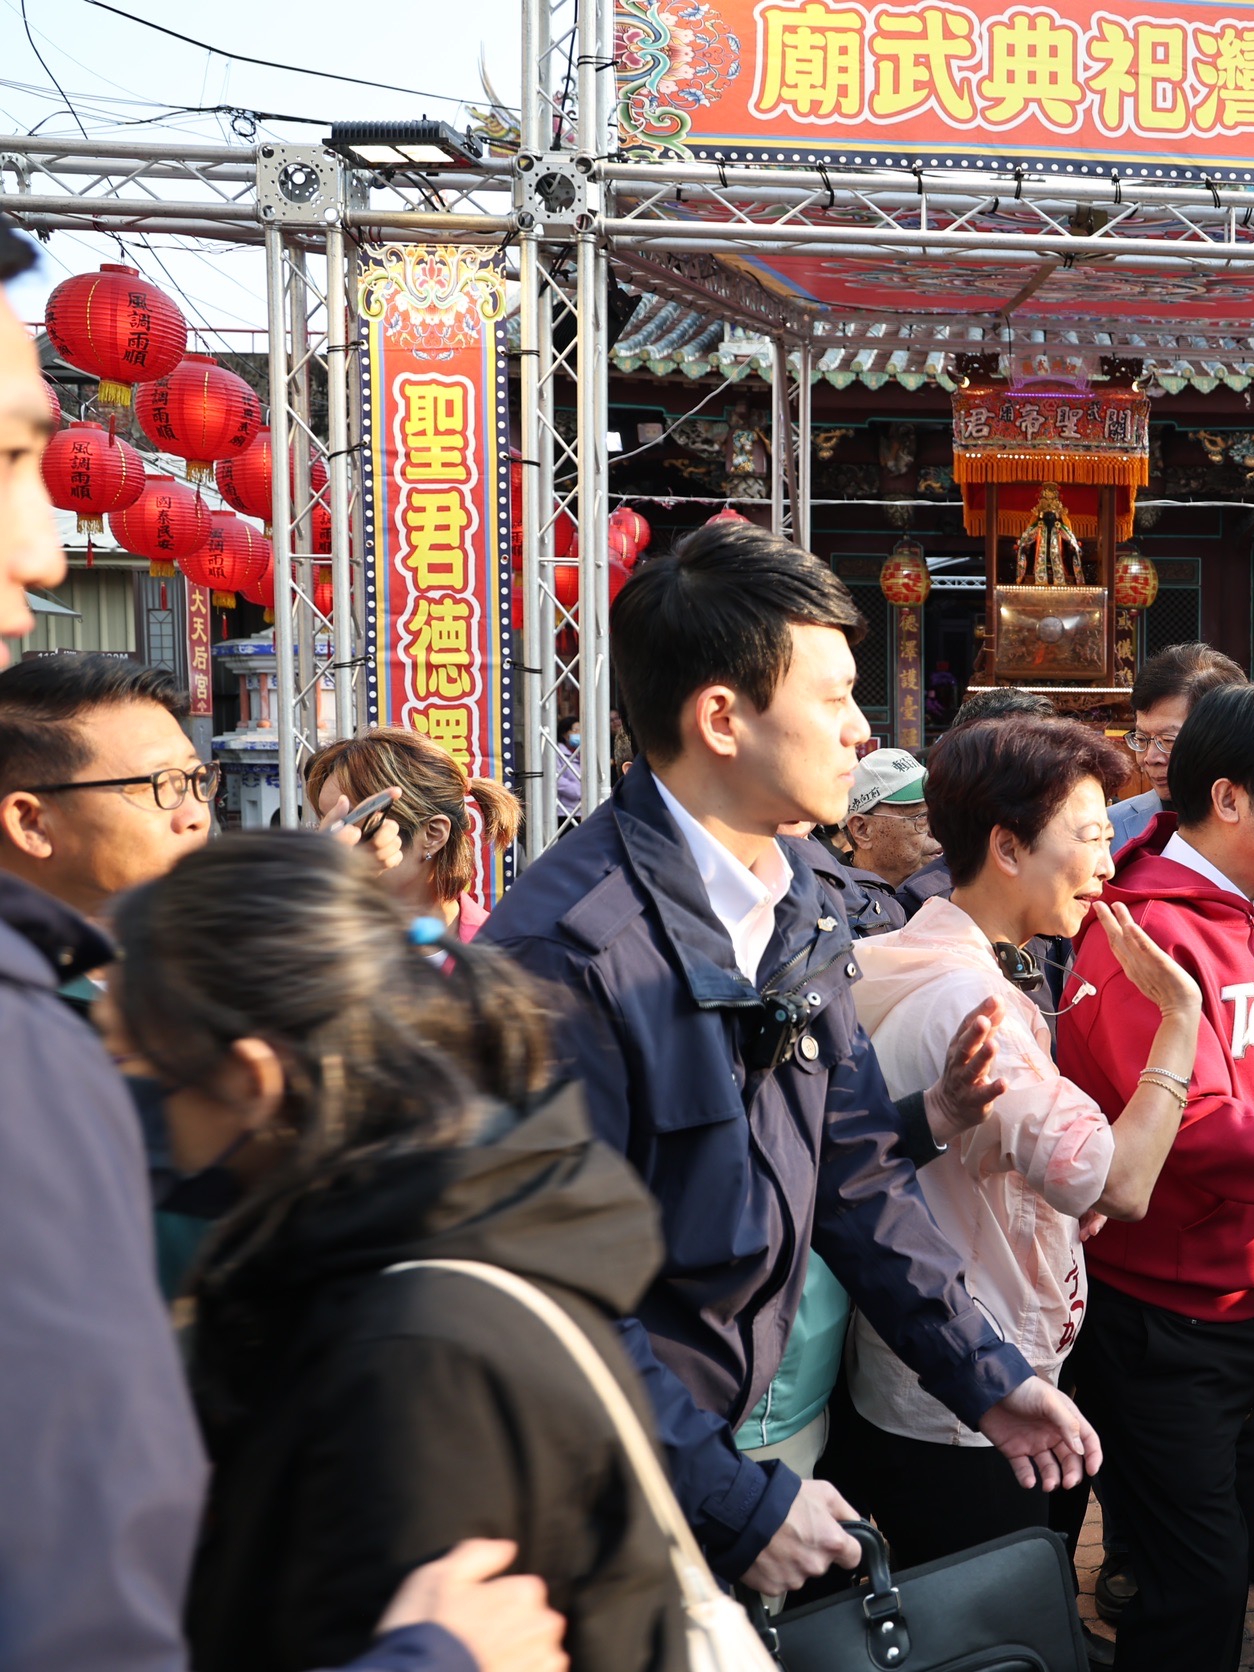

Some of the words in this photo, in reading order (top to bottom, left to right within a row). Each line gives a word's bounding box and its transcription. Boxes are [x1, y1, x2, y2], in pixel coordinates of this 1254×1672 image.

[122, 291, 153, 368] 風調雨順
[70, 441, 93, 501] 風調雨順
[220, 459, 249, 511] 調雨順
[155, 496, 175, 551] 國泰民安
[208, 527, 228, 579] 風調雨順
[190, 588, 209, 699] 大天后宮
